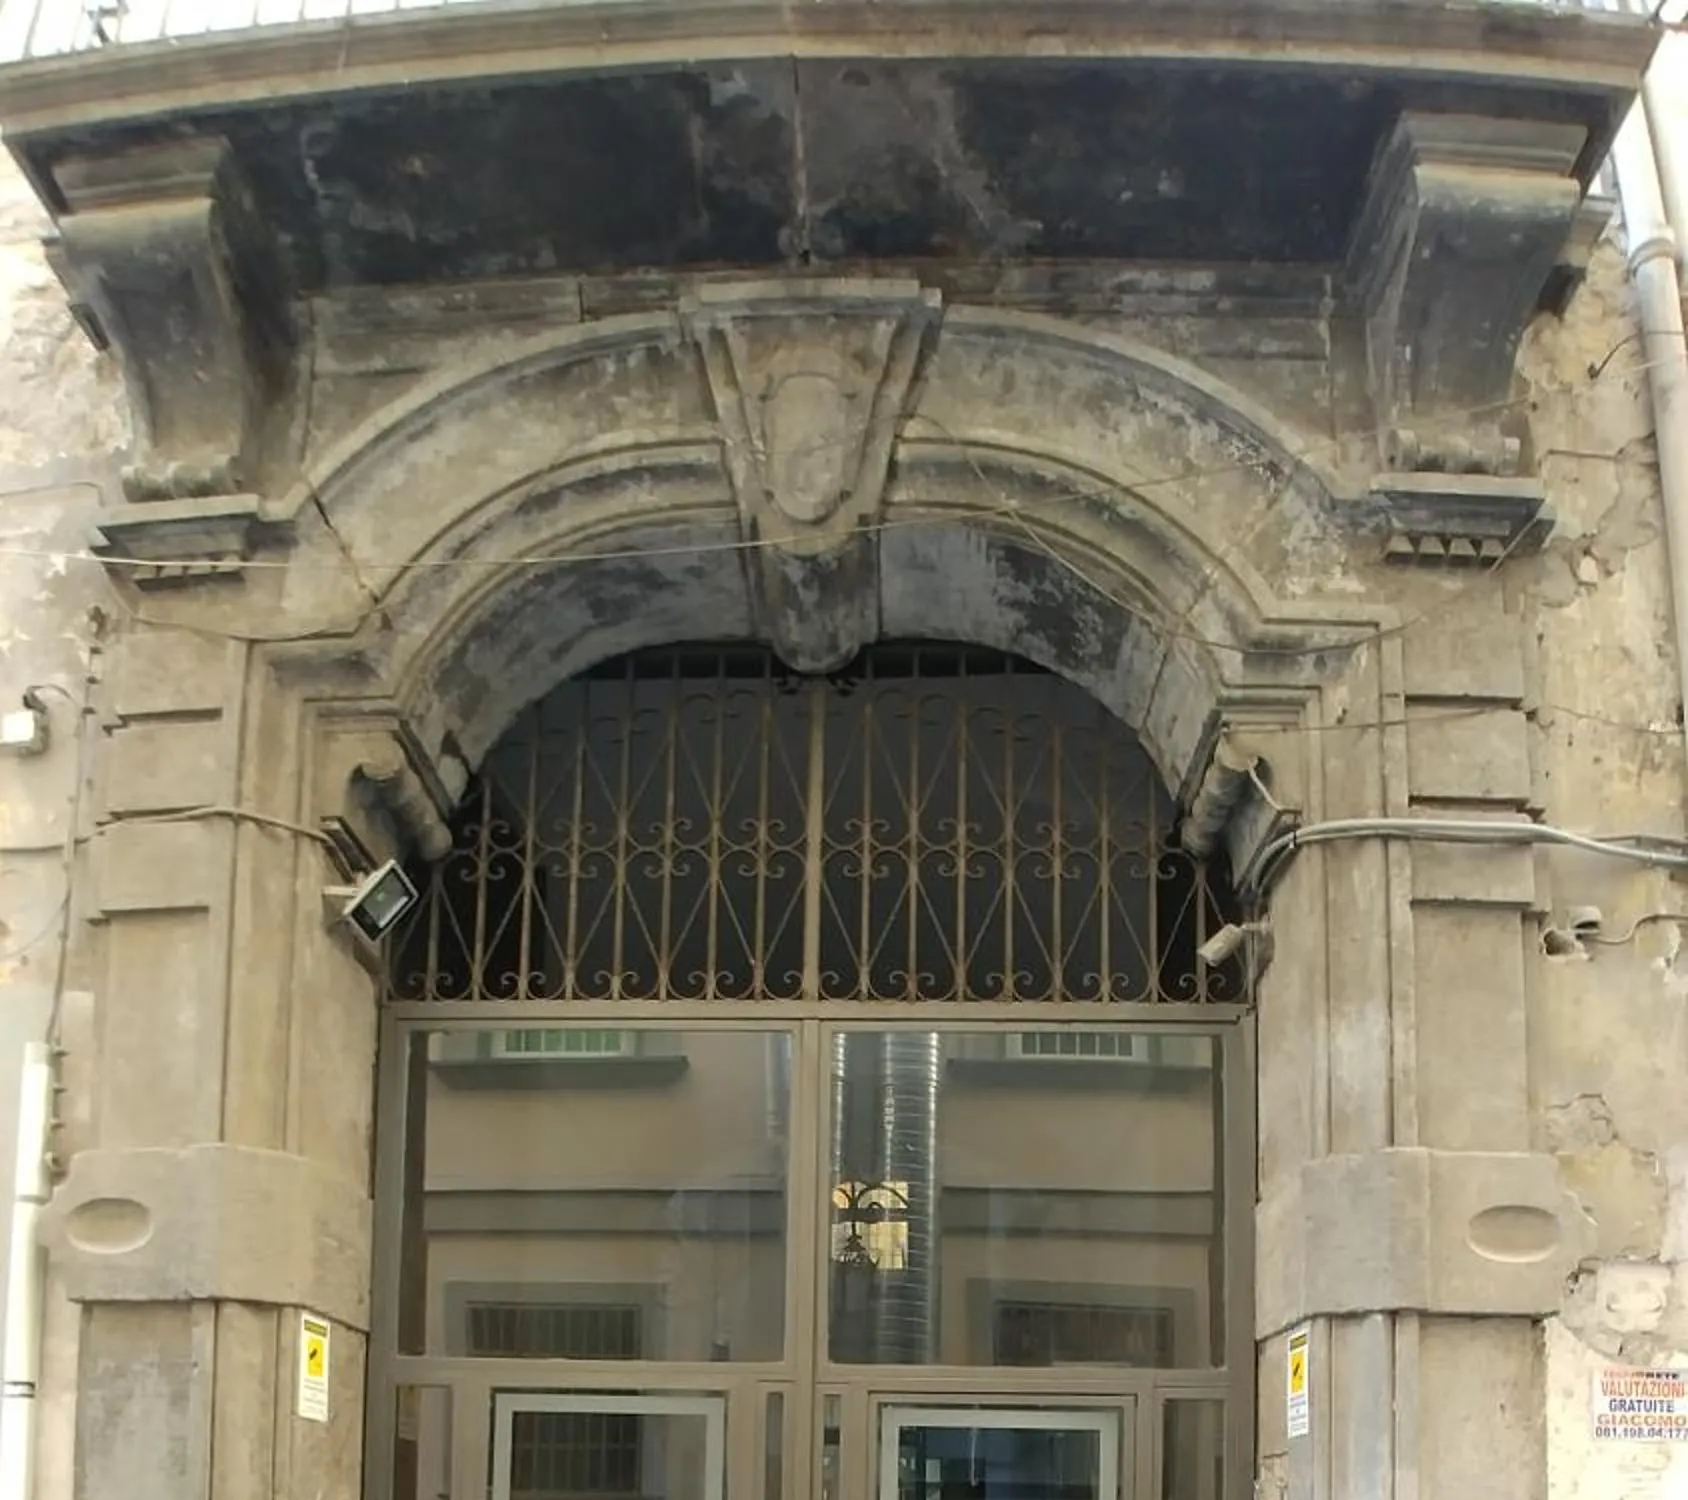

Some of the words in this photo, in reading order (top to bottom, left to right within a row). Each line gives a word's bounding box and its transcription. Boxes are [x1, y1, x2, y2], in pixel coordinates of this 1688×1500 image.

[1601, 1380, 1685, 1398] VALUTAZIONI
[1609, 1398, 1675, 1413] GRATUITE
[1597, 1414, 1687, 1426] GIACOMO
